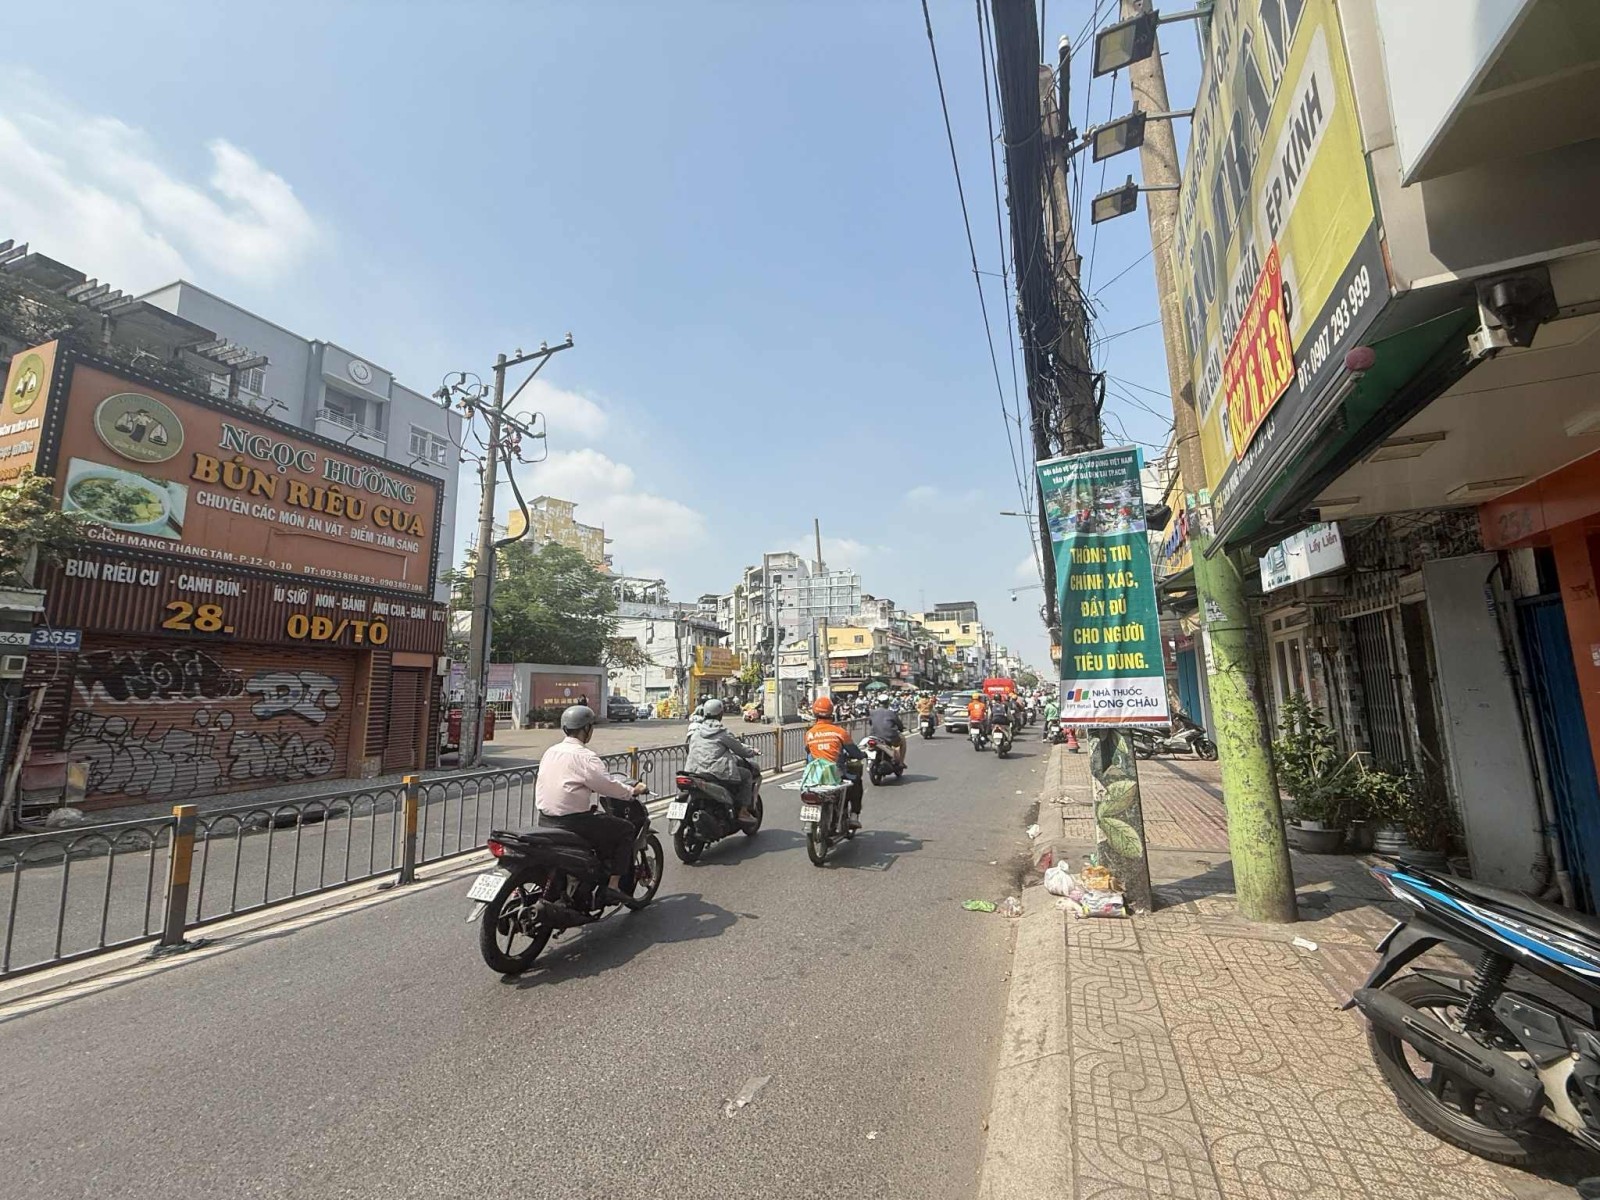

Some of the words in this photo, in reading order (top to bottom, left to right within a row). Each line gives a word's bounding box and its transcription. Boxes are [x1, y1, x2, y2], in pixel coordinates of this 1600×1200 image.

[1266, 176, 1286, 237] ÉP
[1282, 71, 1323, 200] KÍNH
[1235, 243, 1261, 318] CHỮA
[1310, 325, 1330, 374] 0907
[1331, 298, 1350, 345] 293
[1348, 265, 1370, 316] 999
[219, 423, 317, 474] NGỌC
[322, 456, 417, 505] HƯỜNG
[191, 452, 279, 499] BÚN
[286, 479, 367, 522] RIÊU
[373, 504, 426, 537] CUA
[196, 490, 249, 516] CHUYÊN
[252, 503, 276, 522] CÁC
[278, 509, 304, 529] MÓN
[307, 516, 322, 532] ĂN
[350, 524, 374, 543] ĐIỂM
[376, 531, 395, 548] TÂM
[396, 537, 419, 553] SÁNG
[127, 536, 166, 550] MẠNG
[168, 542, 208, 557] THÁNG
[1070, 545, 1107, 564] THÔNG
[1109, 545, 1131, 562] TIN
[102, 561, 138, 584] RIÊU
[178, 574, 212, 594] CANH
[215, 577, 240, 597] BÚN
[342, 595, 366, 612] BÁNH
[391, 602, 406, 617] CUA
[1070, 570, 1105, 591] CHÍNH
[1107, 569, 1139, 589] XÁC,
[1081, 595, 1105, 617] ĐẦY
[1109, 593, 1127, 616] ĐỦ
[0, 633, 25, 644] 363
[35, 630, 77, 645] 365
[1073, 627, 1100, 644] CHO
[1103, 622, 1145, 643] NGƯỜI
[1074, 652, 1104, 671] TIÊU
[1107, 650, 1149, 671] DÙNG.
[1092, 687, 1111, 697] NHÀ
[1112, 685, 1143, 697] THUỐC
[1093, 699, 1124, 709] LONG
[1126, 695, 1158, 708] CHÂU
